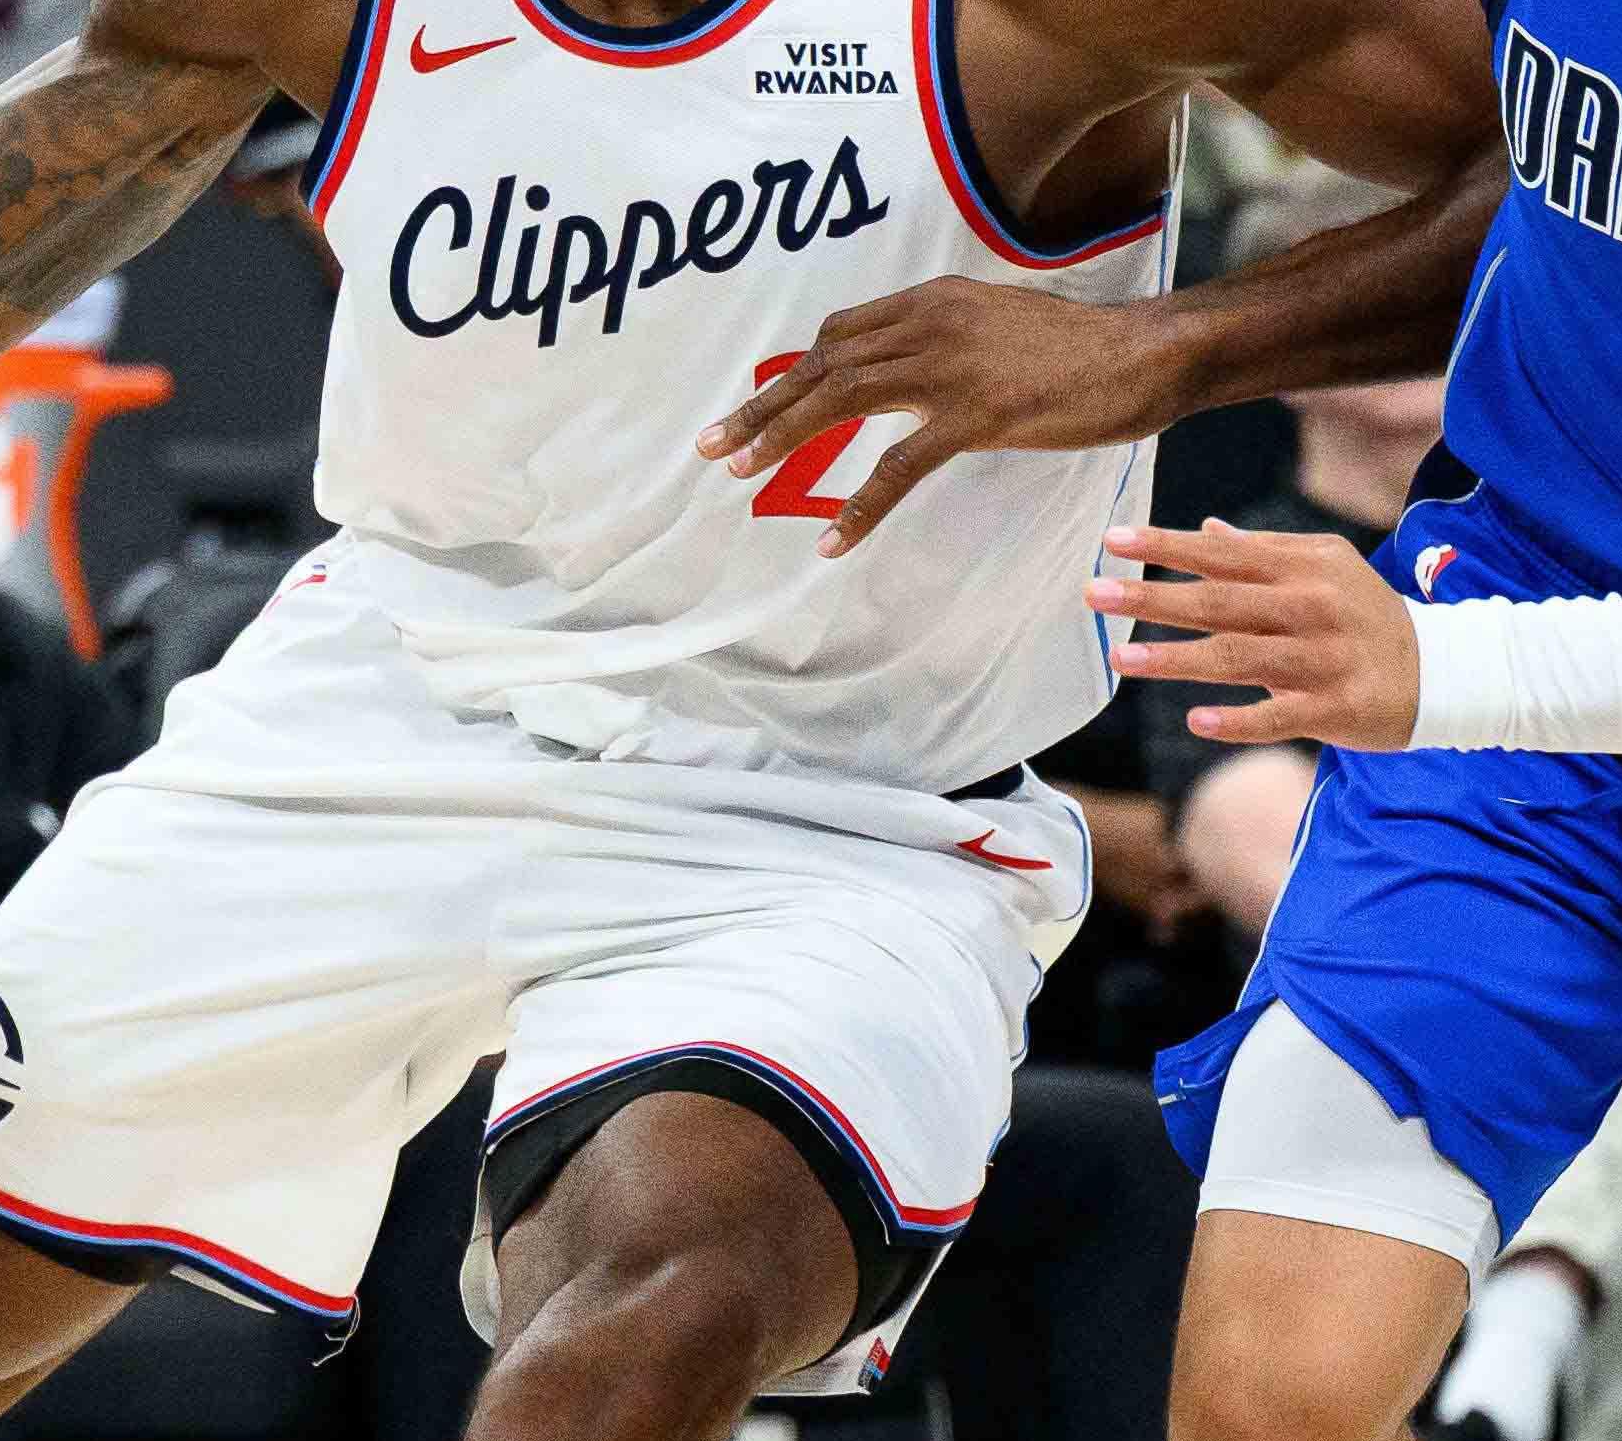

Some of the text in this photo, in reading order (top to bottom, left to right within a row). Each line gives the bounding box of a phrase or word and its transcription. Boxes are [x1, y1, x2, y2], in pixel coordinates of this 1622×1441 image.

[785, 43, 868, 67] VISIT
[754, 70, 899, 95] RWANDA
[389, 135, 891, 348] Clippers
